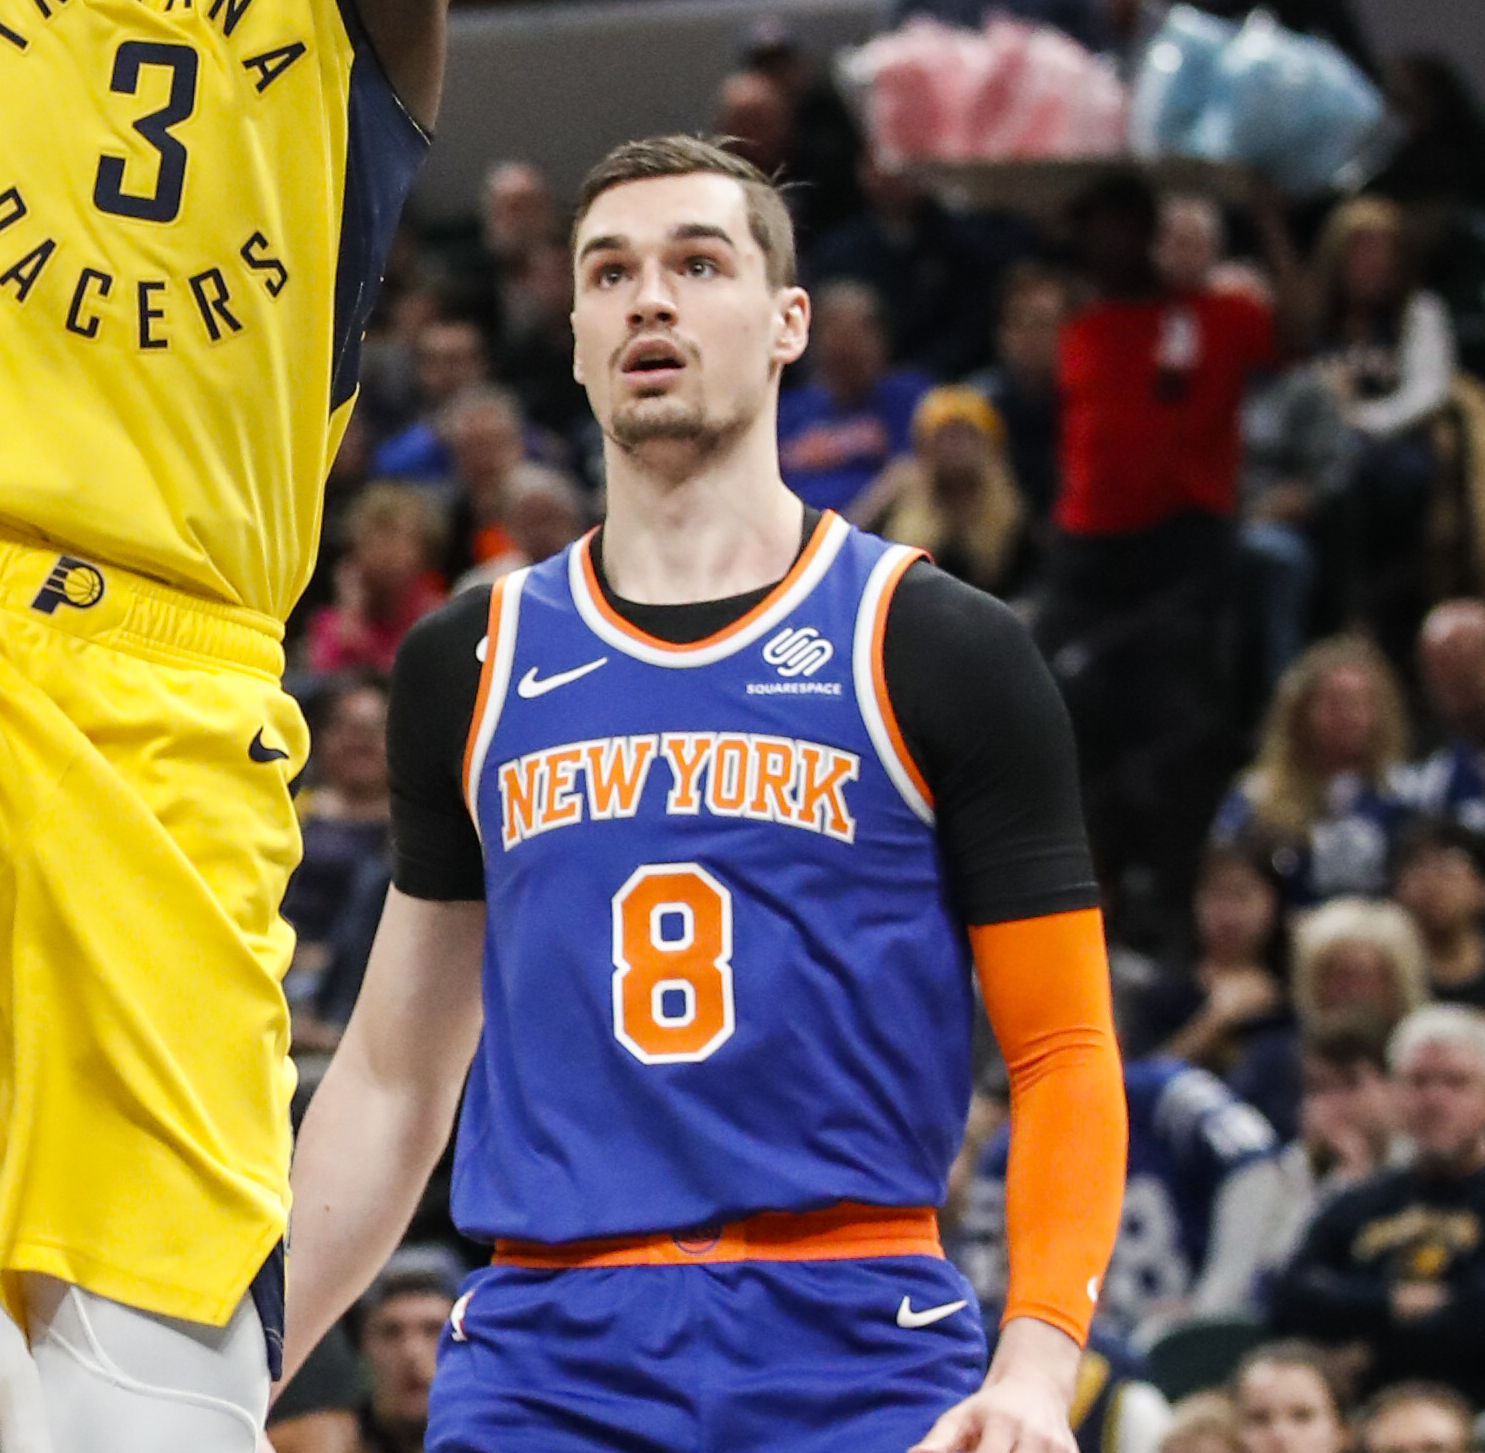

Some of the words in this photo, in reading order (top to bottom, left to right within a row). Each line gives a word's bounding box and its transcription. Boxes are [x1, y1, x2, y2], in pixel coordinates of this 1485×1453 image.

[92, 40, 198, 224] 3
[746, 682, 842, 695] SQUARESPACE
[498, 733, 659, 852] NEW
[660, 731, 860, 845] YORK
[612, 861, 735, 1065] 8
